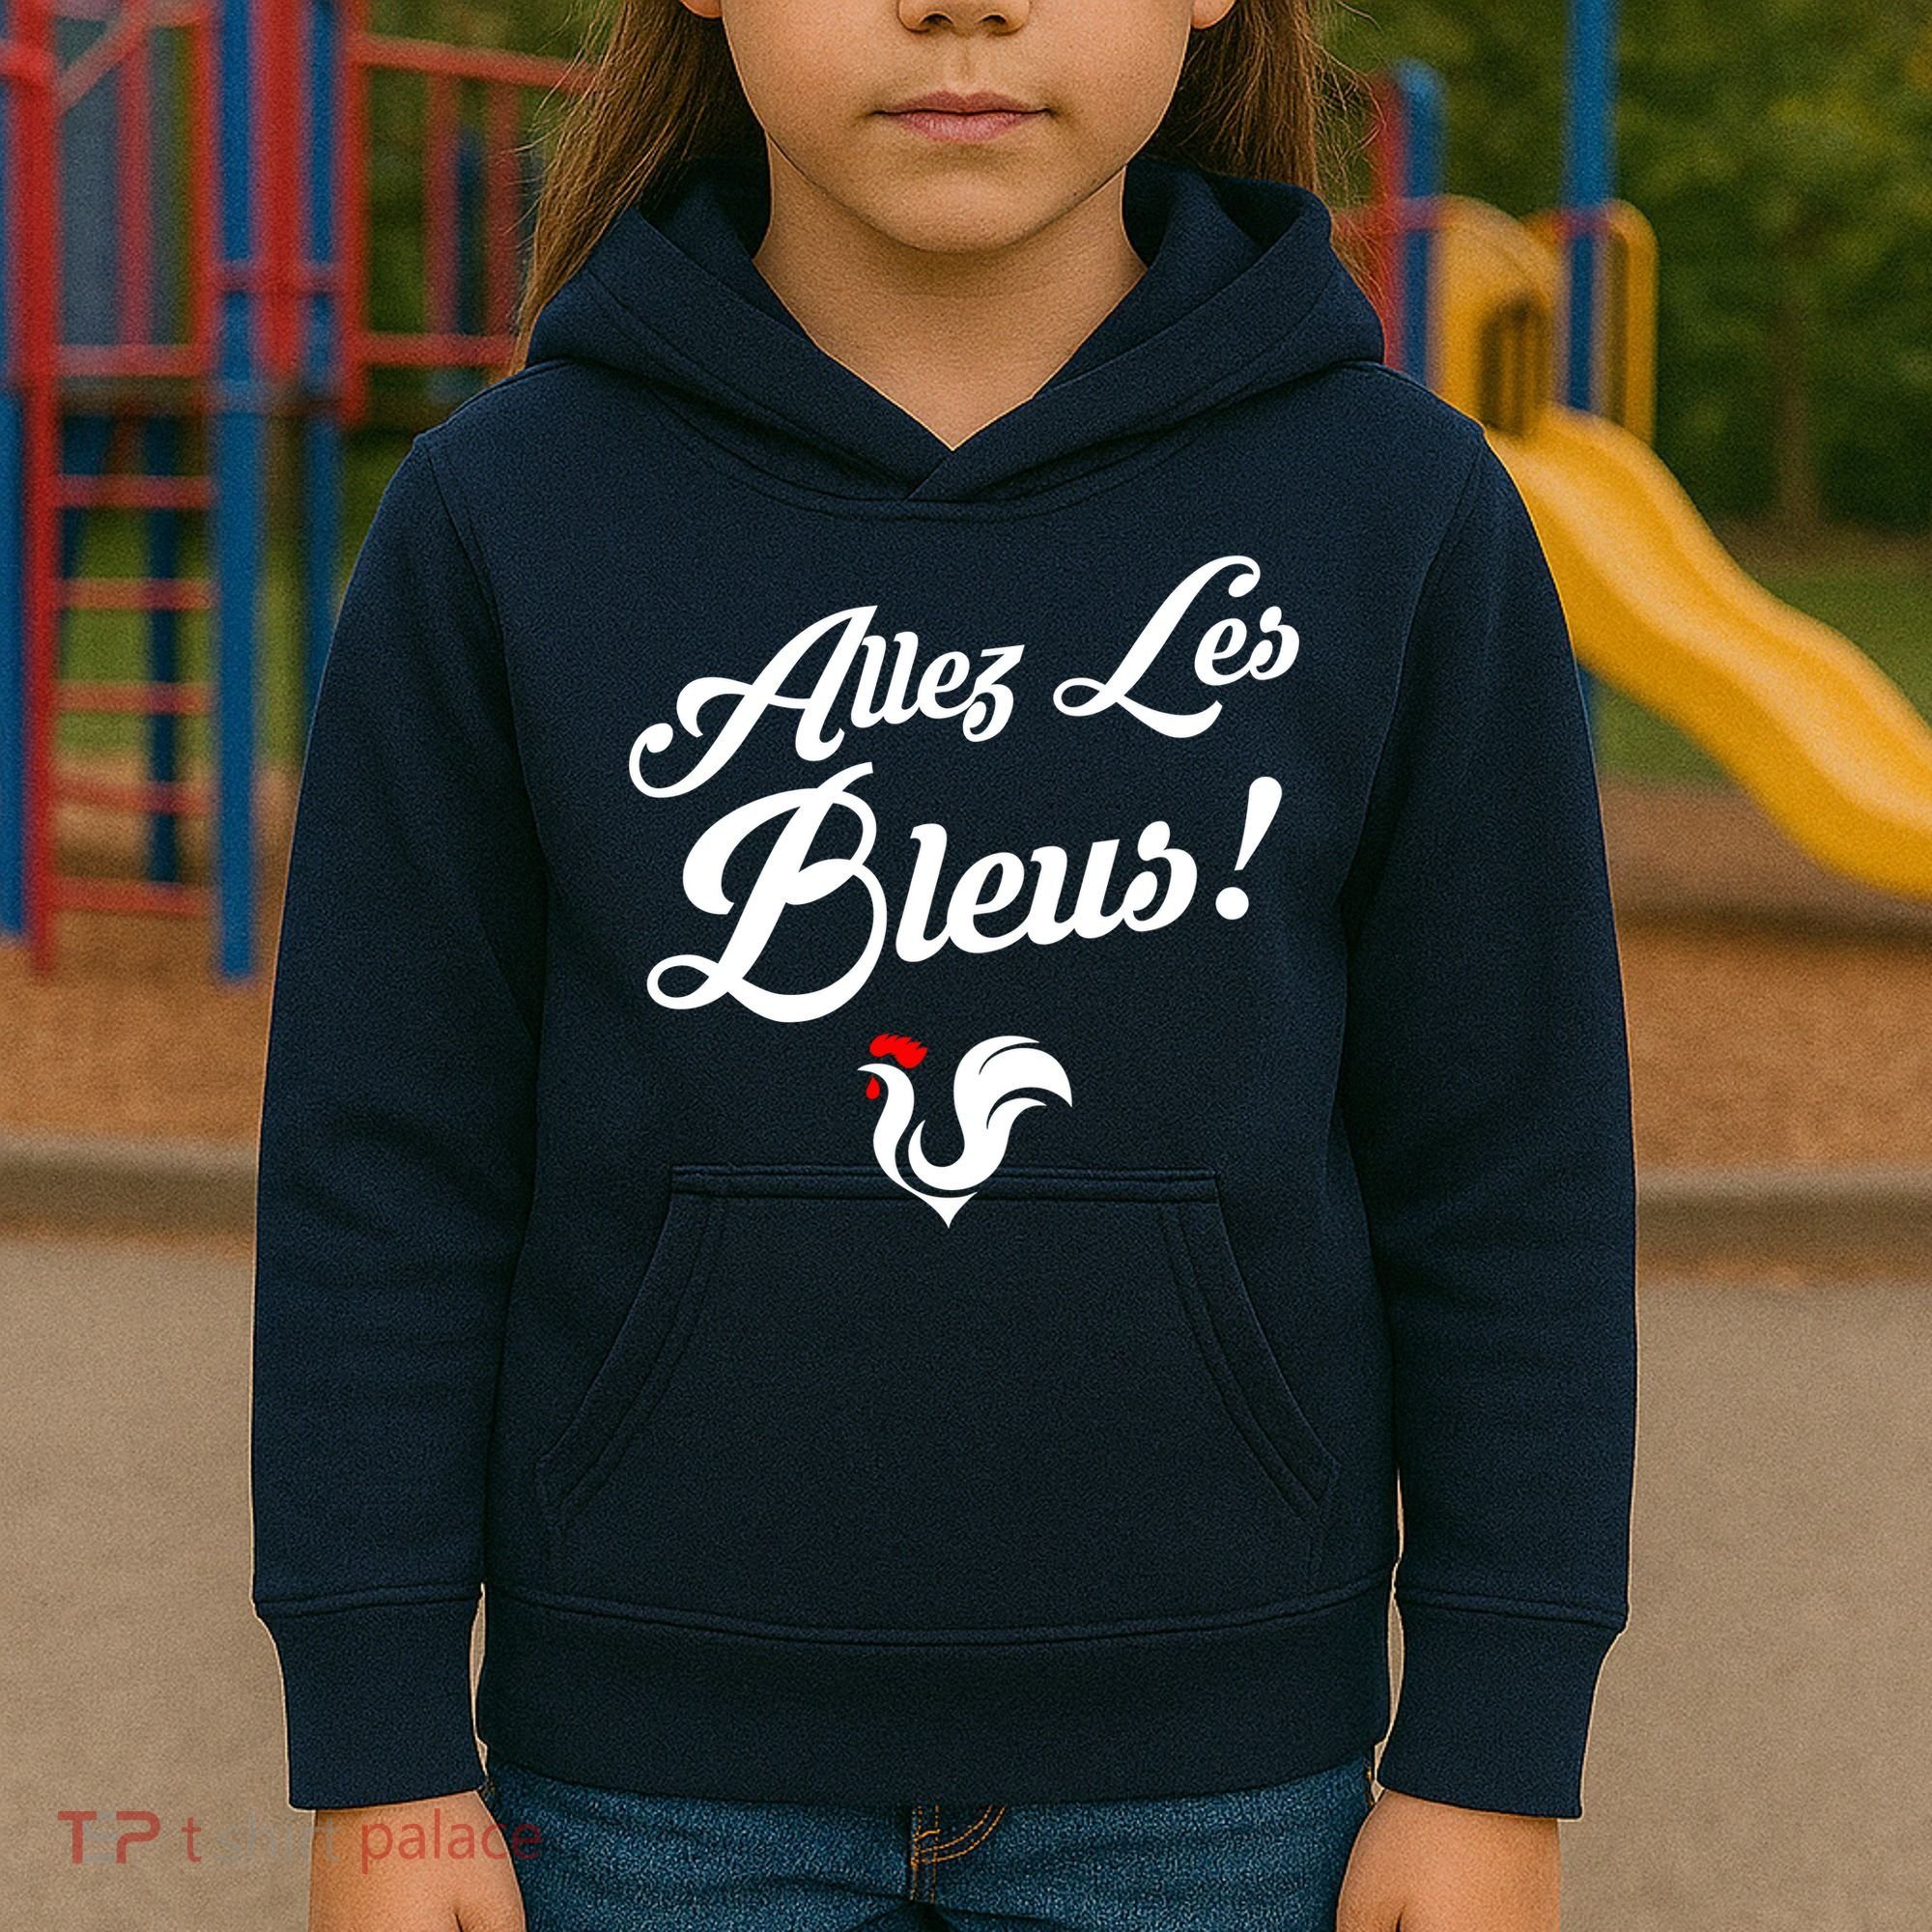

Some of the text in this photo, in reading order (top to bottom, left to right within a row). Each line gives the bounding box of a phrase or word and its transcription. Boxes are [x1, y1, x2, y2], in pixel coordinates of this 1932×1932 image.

[629, 555, 1300, 799] Allez Les
[647, 761, 1283, 1023] Bleus!
